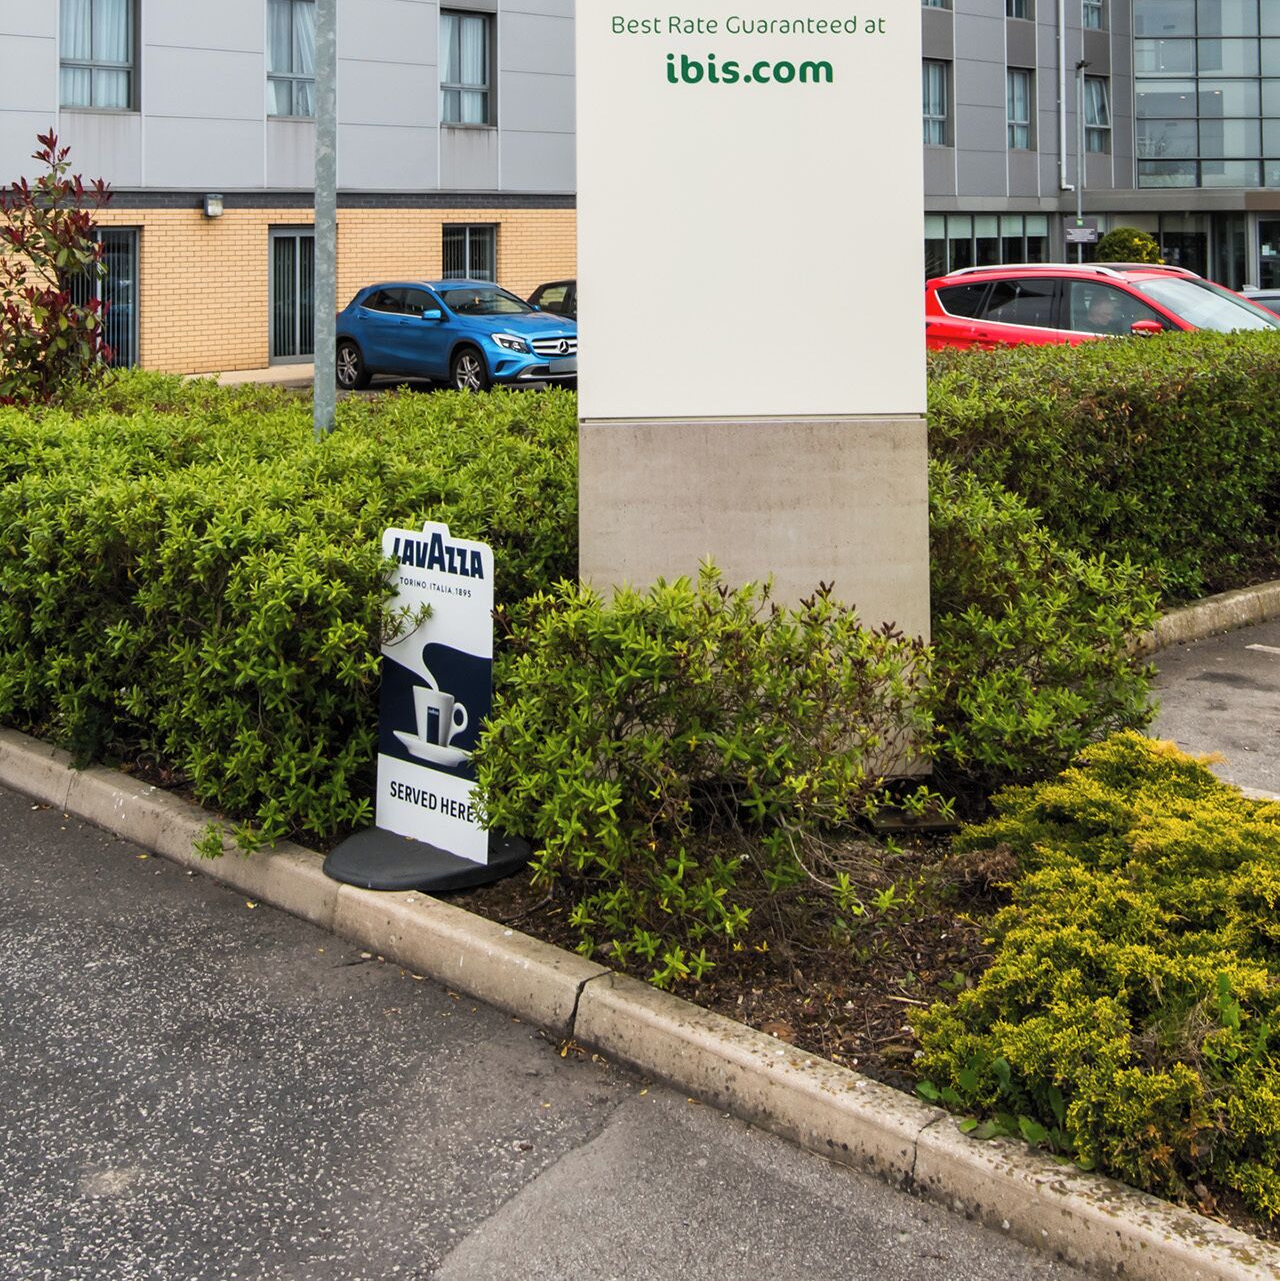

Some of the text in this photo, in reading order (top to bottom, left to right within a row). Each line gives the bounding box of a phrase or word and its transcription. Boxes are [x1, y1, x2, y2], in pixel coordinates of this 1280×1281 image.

[611, 15, 887, 35] Best Rate Guaranteed at
[666, 52, 834, 84] ibis.com
[393, 532, 485, 580] LAVAZZA
[455, 587, 472, 599] 1895
[390, 780, 475, 824] SERVED HERE
